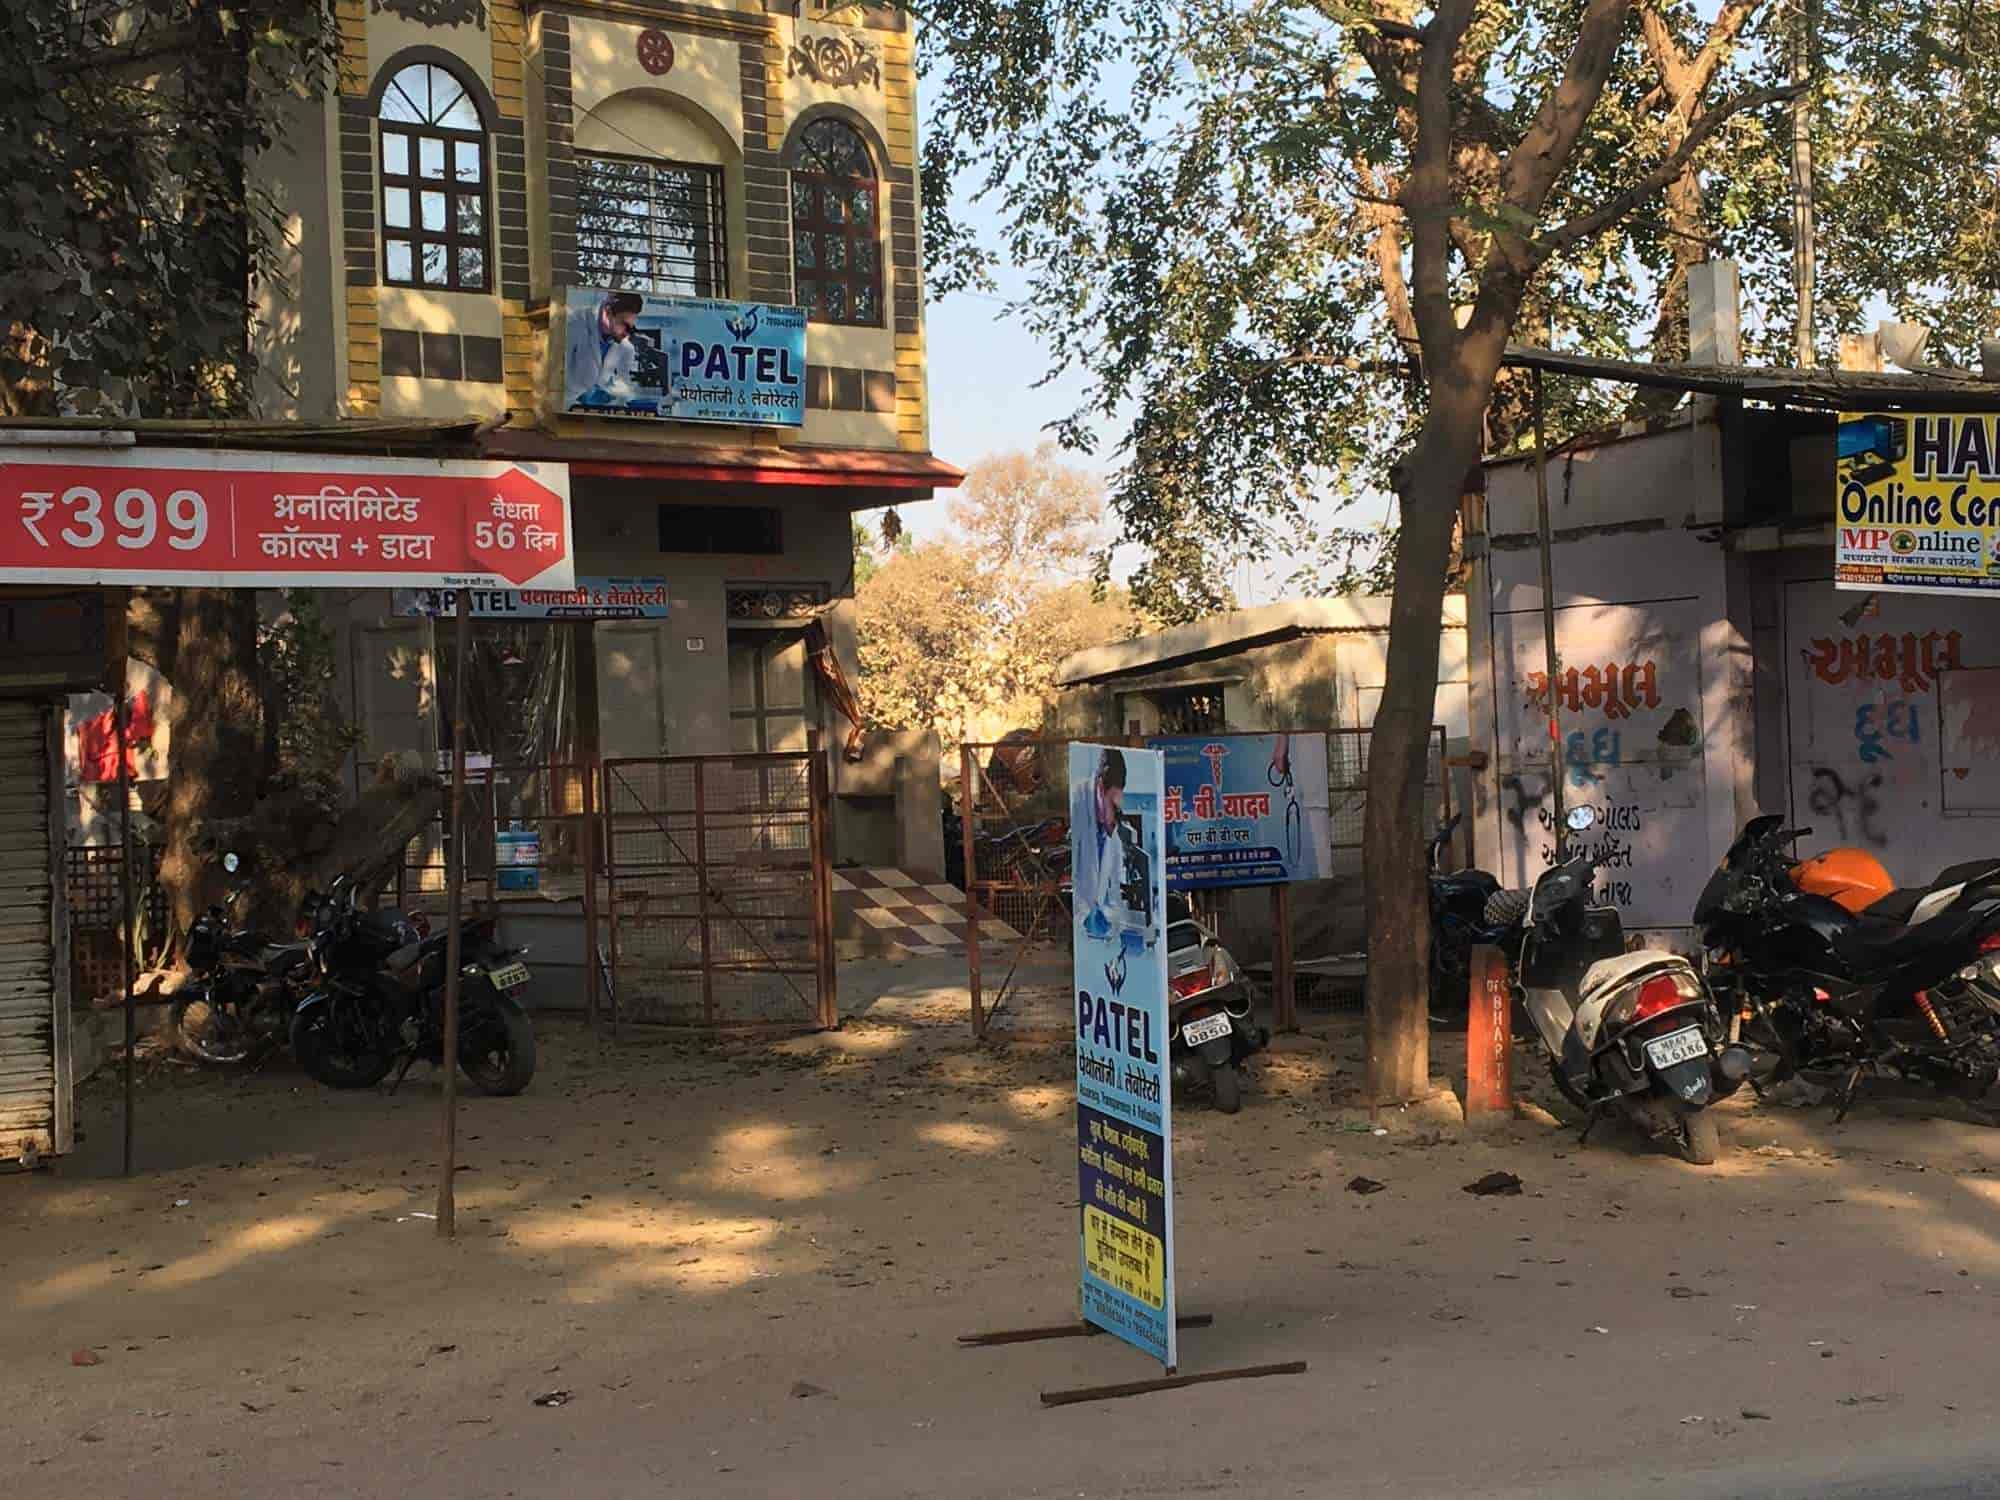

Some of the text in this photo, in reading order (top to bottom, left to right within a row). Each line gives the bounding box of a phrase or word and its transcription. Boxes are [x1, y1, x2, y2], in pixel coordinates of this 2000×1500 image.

[681, 342, 799, 385] PATEL
[737, 390, 747, 405] &
[1913, 416, 2000, 480] HA
[273, 488, 421, 523] अनलिमिटेड
[490, 493, 541, 521] वैधता
[1841, 481, 1943, 524] Online
[258, 526, 434, 561] कॉल्स + डाटा
[474, 522, 558, 553] 56 दिन
[1078, 990, 1158, 1065] PATEL
